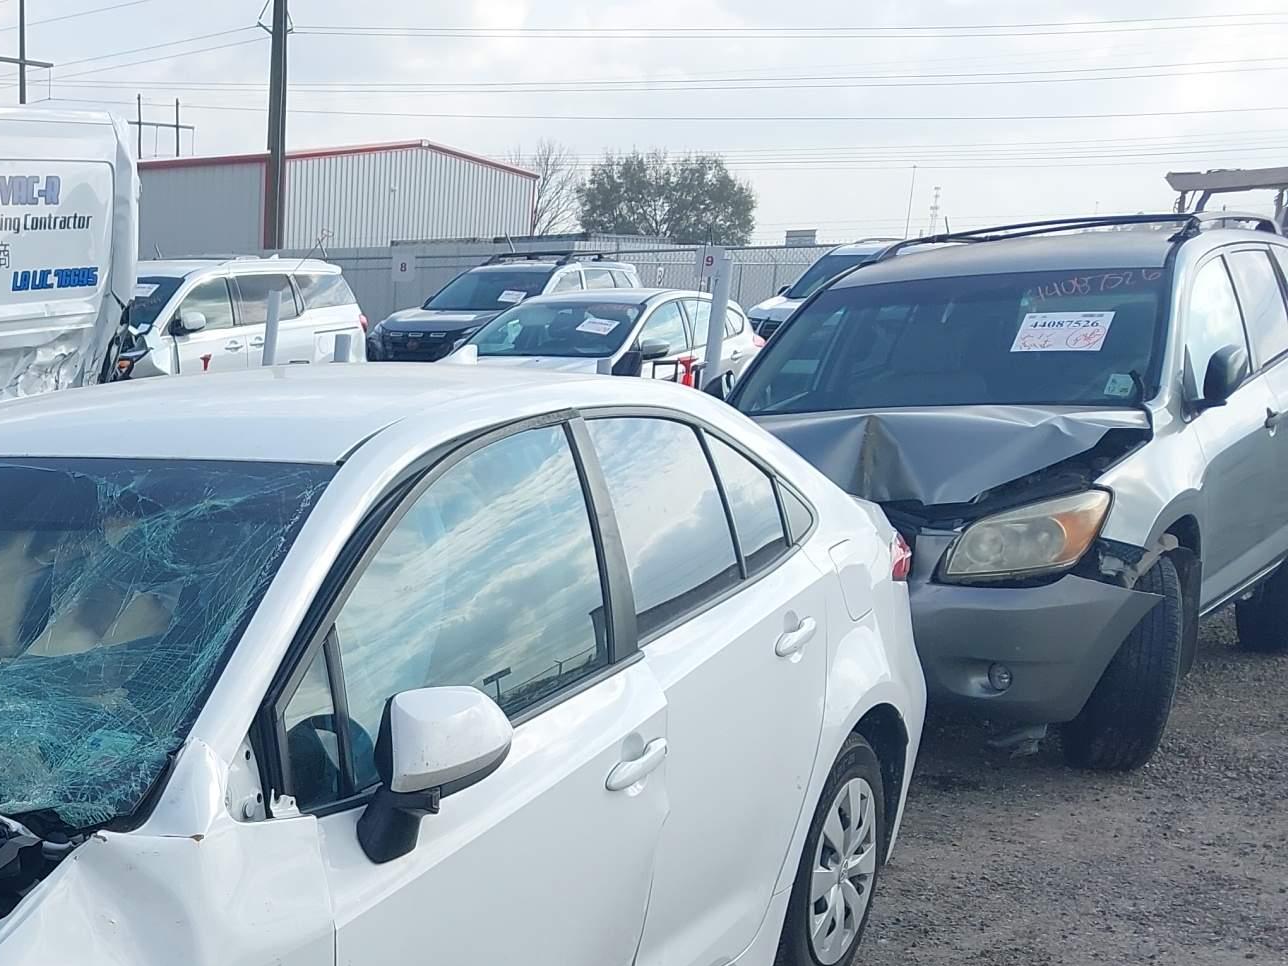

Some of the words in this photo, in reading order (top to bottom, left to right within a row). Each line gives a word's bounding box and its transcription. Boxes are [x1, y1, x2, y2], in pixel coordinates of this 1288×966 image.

[24, 212, 93, 231] Contractor
[400, 262, 407, 272] 8
[705, 255, 714, 267] 9
[12, 271, 31, 291] LA
[1029, 319, 1100, 329] 44087526
